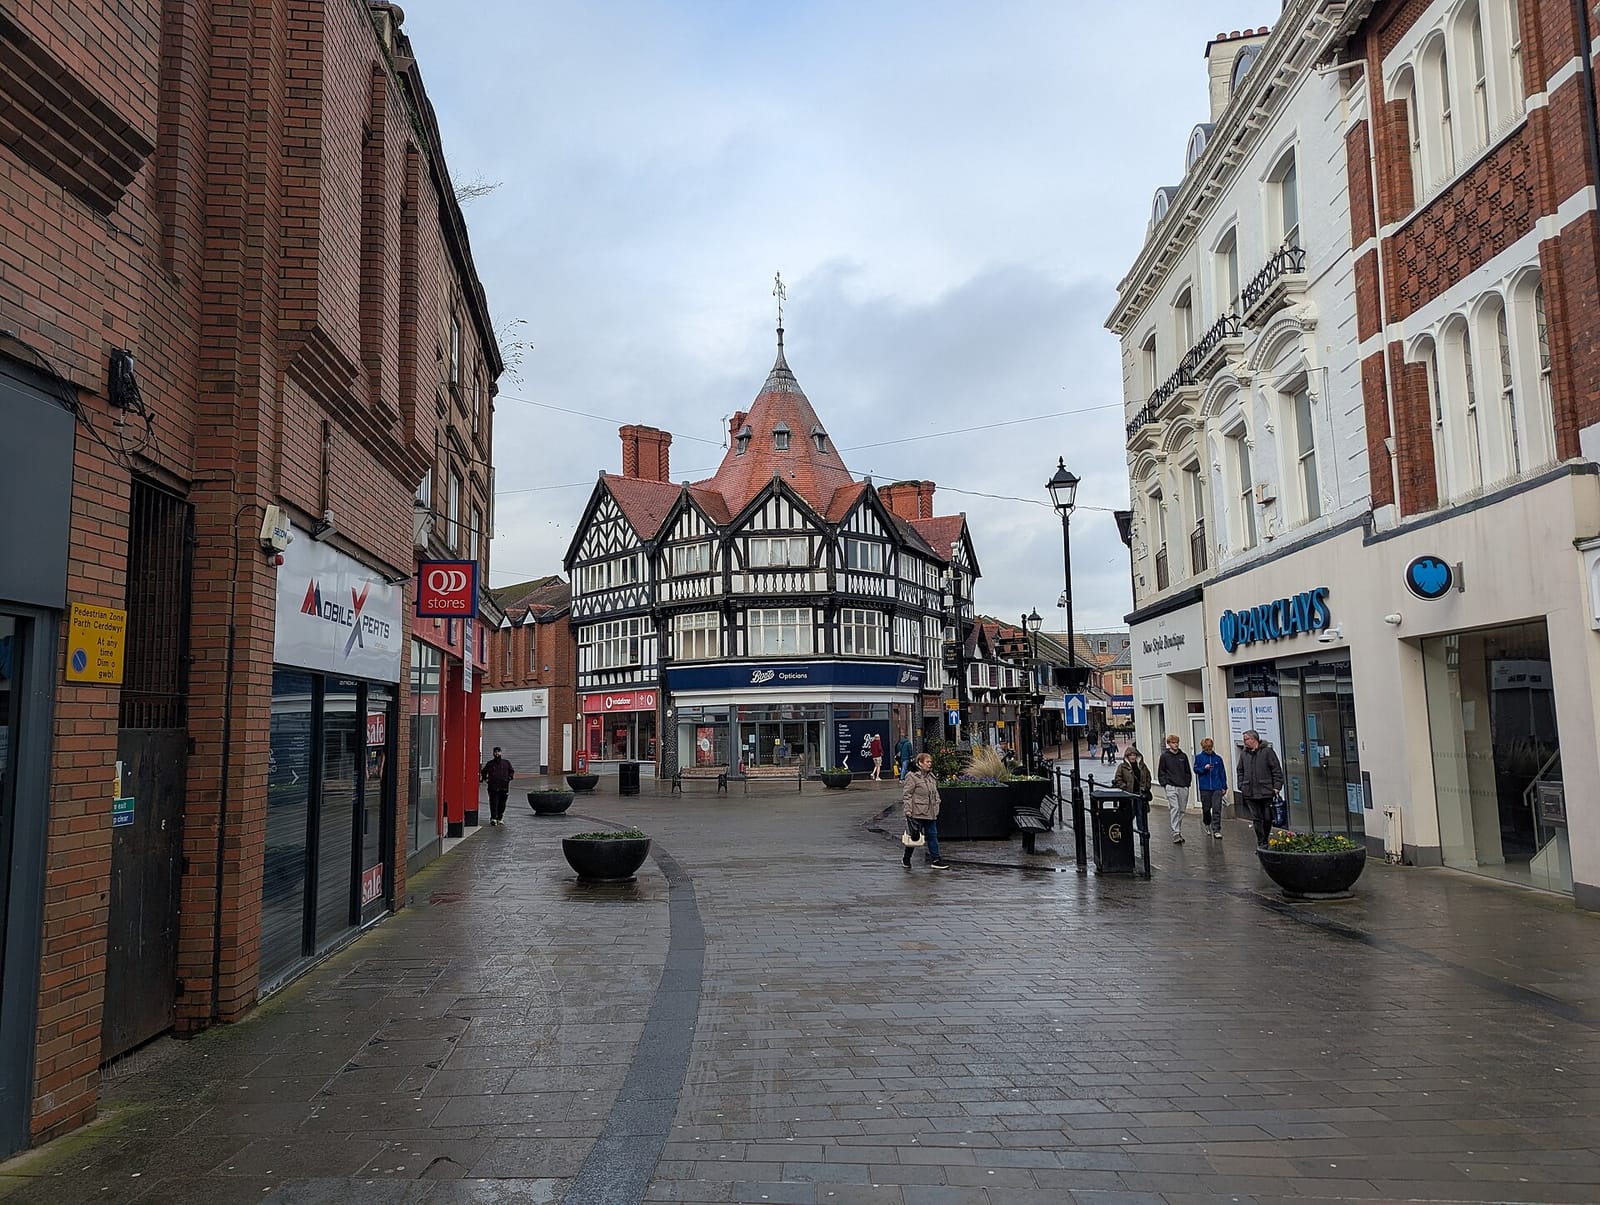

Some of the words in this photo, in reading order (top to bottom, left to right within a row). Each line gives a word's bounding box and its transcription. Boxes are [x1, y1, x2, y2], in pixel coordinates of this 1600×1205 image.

[428, 570, 467, 596] QD
[427, 597, 466, 609] stores
[74, 606, 107, 619] Pedestrian
[109, 612, 124, 622] Zone
[1237, 587, 1330, 646] BARCLAYS
[73, 617, 91, 628] Parth
[93, 620, 123, 633] Cerddwyr
[97, 637, 105, 646] At
[107, 639, 118, 648] any
[1153, 637, 1163, 655] Style
[1164, 633, 1185, 651] Boutique
[100, 648, 113, 657] time
[97, 658, 109, 667] Dim
[98, 670, 114, 679] gwbl
[750, 669, 775, 684] Boots
[778, 672, 808, 680] Opticians
[492, 704, 509, 713] WARREN
[510, 704, 524, 713] JAMES
[366, 716, 384, 743] sale
[362, 869, 382, 903] sale
